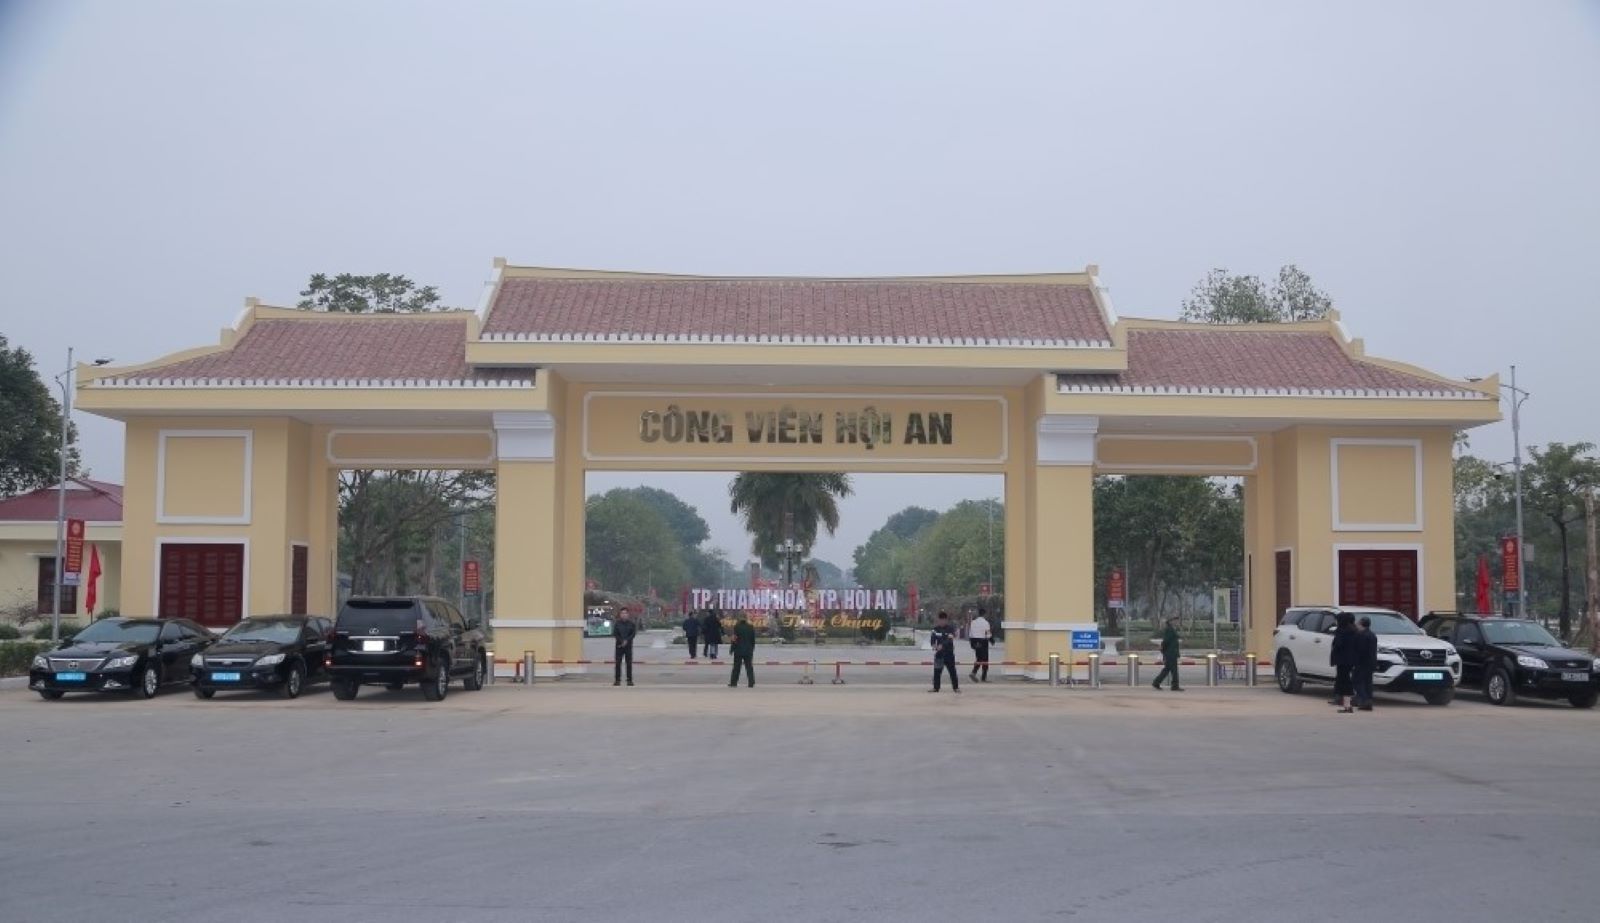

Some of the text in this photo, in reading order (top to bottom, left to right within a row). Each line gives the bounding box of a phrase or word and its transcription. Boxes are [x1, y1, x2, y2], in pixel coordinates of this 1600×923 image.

[639, 404, 953, 450] CÔNG VIÊN HỘI AN
[692, 589, 714, 610] TP.
[717, 589, 769, 610] THANH
[843, 584, 872, 619] HỘI
[875, 589, 897, 610] AN
